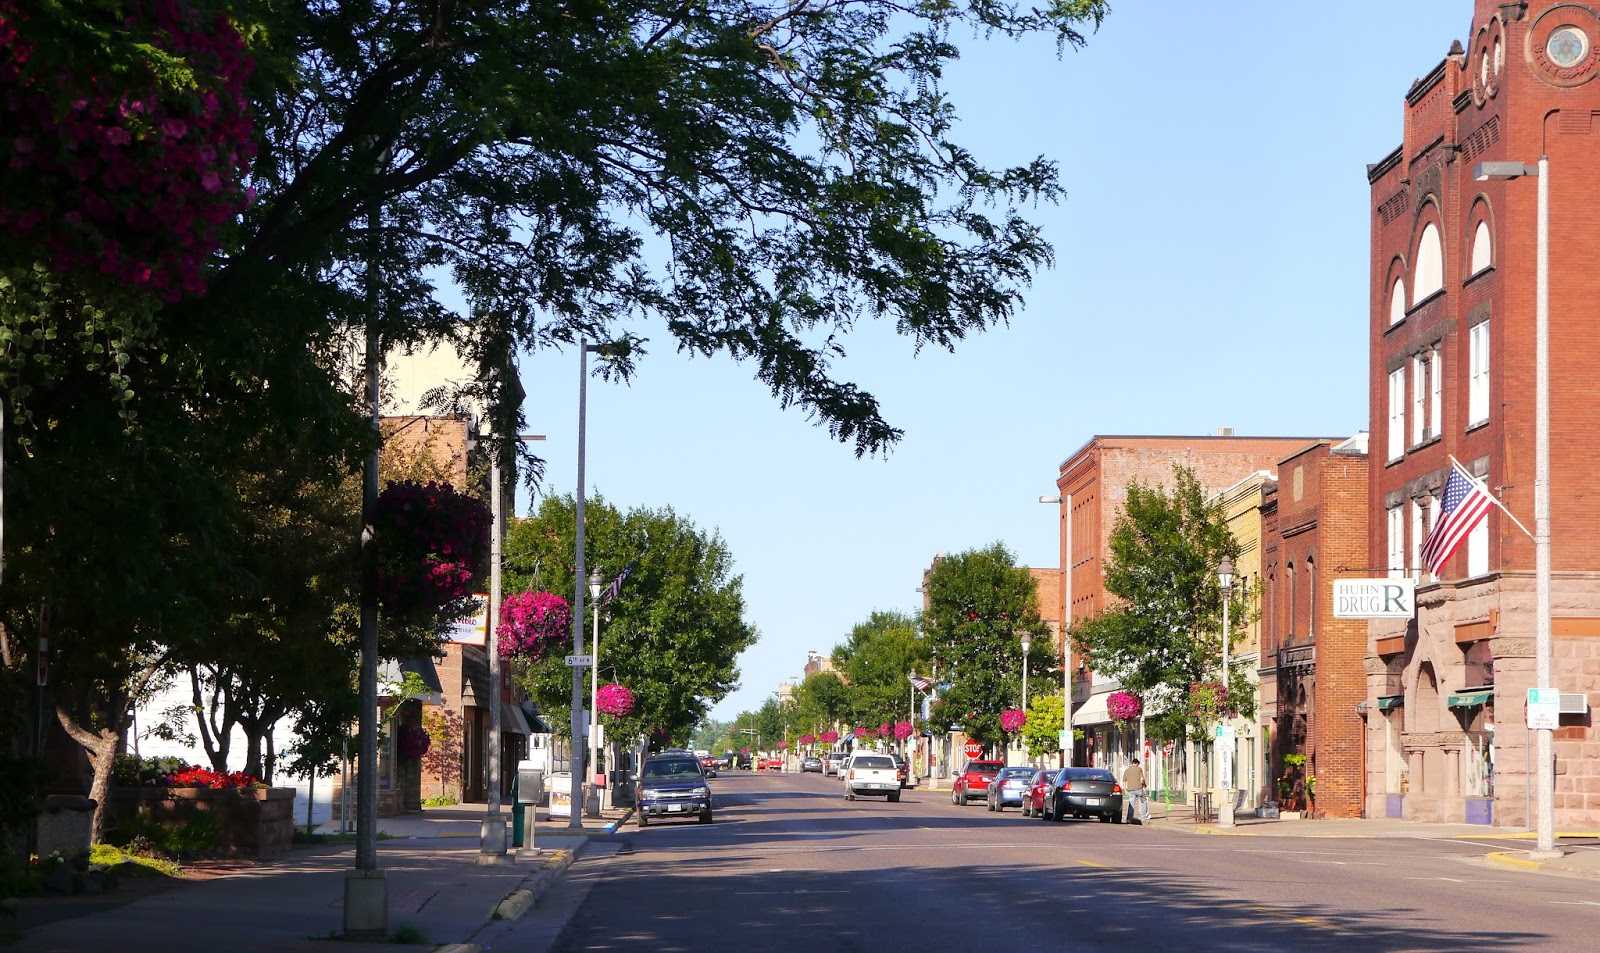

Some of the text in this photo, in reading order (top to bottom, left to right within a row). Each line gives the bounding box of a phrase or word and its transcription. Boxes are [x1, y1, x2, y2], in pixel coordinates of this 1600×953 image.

[1339, 584, 1379, 595] HUHN
[1339, 596, 1380, 613] DRUG
[965, 744, 981, 753] STOP
